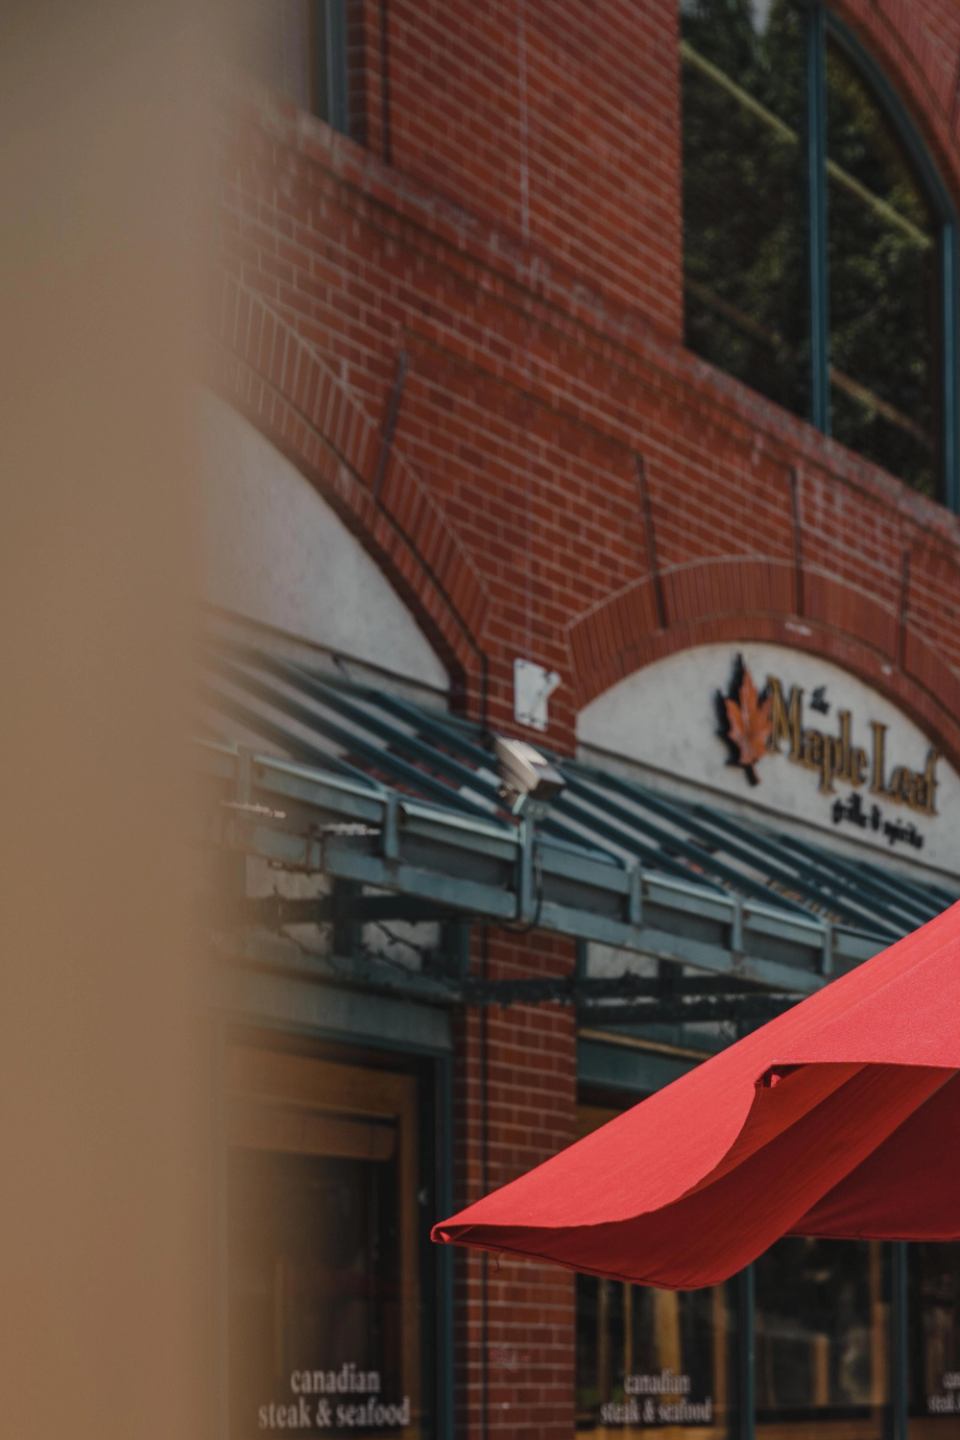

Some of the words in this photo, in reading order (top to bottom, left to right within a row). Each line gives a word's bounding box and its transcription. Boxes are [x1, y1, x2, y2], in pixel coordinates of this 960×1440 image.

[765, 674, 867, 795] Maple
[868, 720, 941, 817] Leaf
[290, 1361, 381, 1394] canadian
[624, 1368, 690, 1395] canadian
[258, 1397, 312, 1429] steak
[315, 1398, 333, 1428] &
[336, 1396, 411, 1426] seafood
[600, 1396, 640, 1425] steak
[642, 1397, 656, 1424] &
[658, 1396, 712, 1423] seafood
